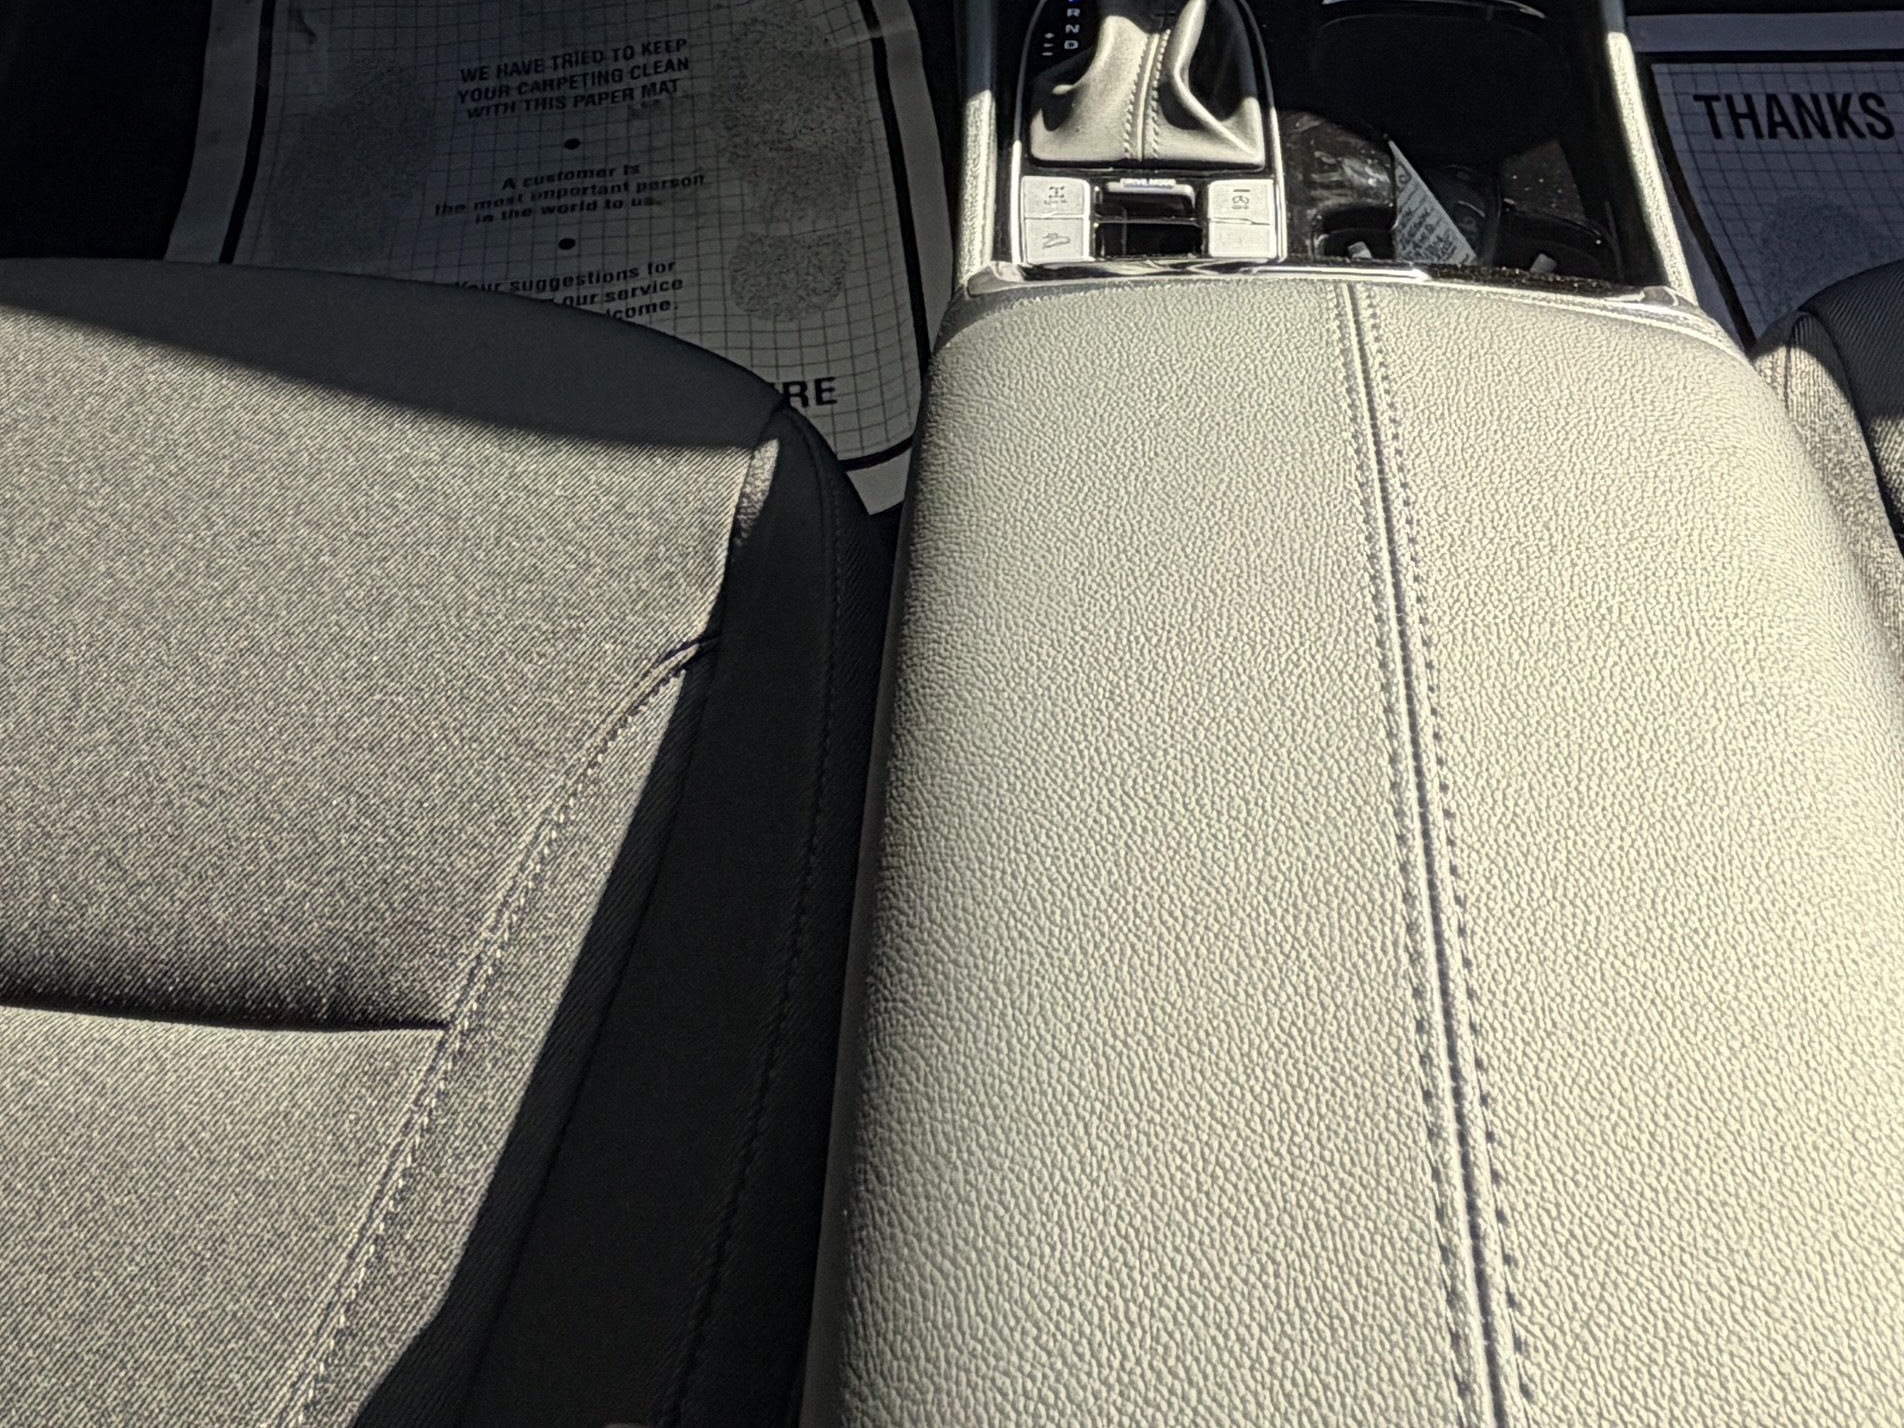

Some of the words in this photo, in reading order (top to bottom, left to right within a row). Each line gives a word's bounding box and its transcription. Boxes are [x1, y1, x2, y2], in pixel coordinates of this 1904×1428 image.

[1064, 24, 1081, 35] N
[1066, 7, 1081, 18] R
[460, 65, 490, 83] WE
[495, 58, 545, 79] HAVE
[551, 49, 605, 70] TRIED
[611, 45, 636, 62] TO
[641, 38, 688, 58] KEEP
[457, 84, 512, 105] YOUR
[517, 68, 624, 96] CARPETING
[629, 56, 690, 81] CLEAN
[466, 102, 517, 120] WITH
[524, 95, 567, 114] THIS
[572, 86, 636, 109] PAPER
[640, 78, 681, 99] MAT
[1693, 90, 1897, 142] THANKS
[433, 202, 467, 217] the
[473, 192, 524, 210] most
[530, 182, 630, 204] important
[634, 173, 706, 194] person
[501, 177, 517, 191] A
[522, 165, 617, 189] customer
[501, 205, 533, 221] the
[540, 200, 598, 215] world
[604, 198, 625, 210] to
[509, 266, 640, 294] suggestions
[646, 260, 677, 276] for
[604, 278, 684, 303] service
